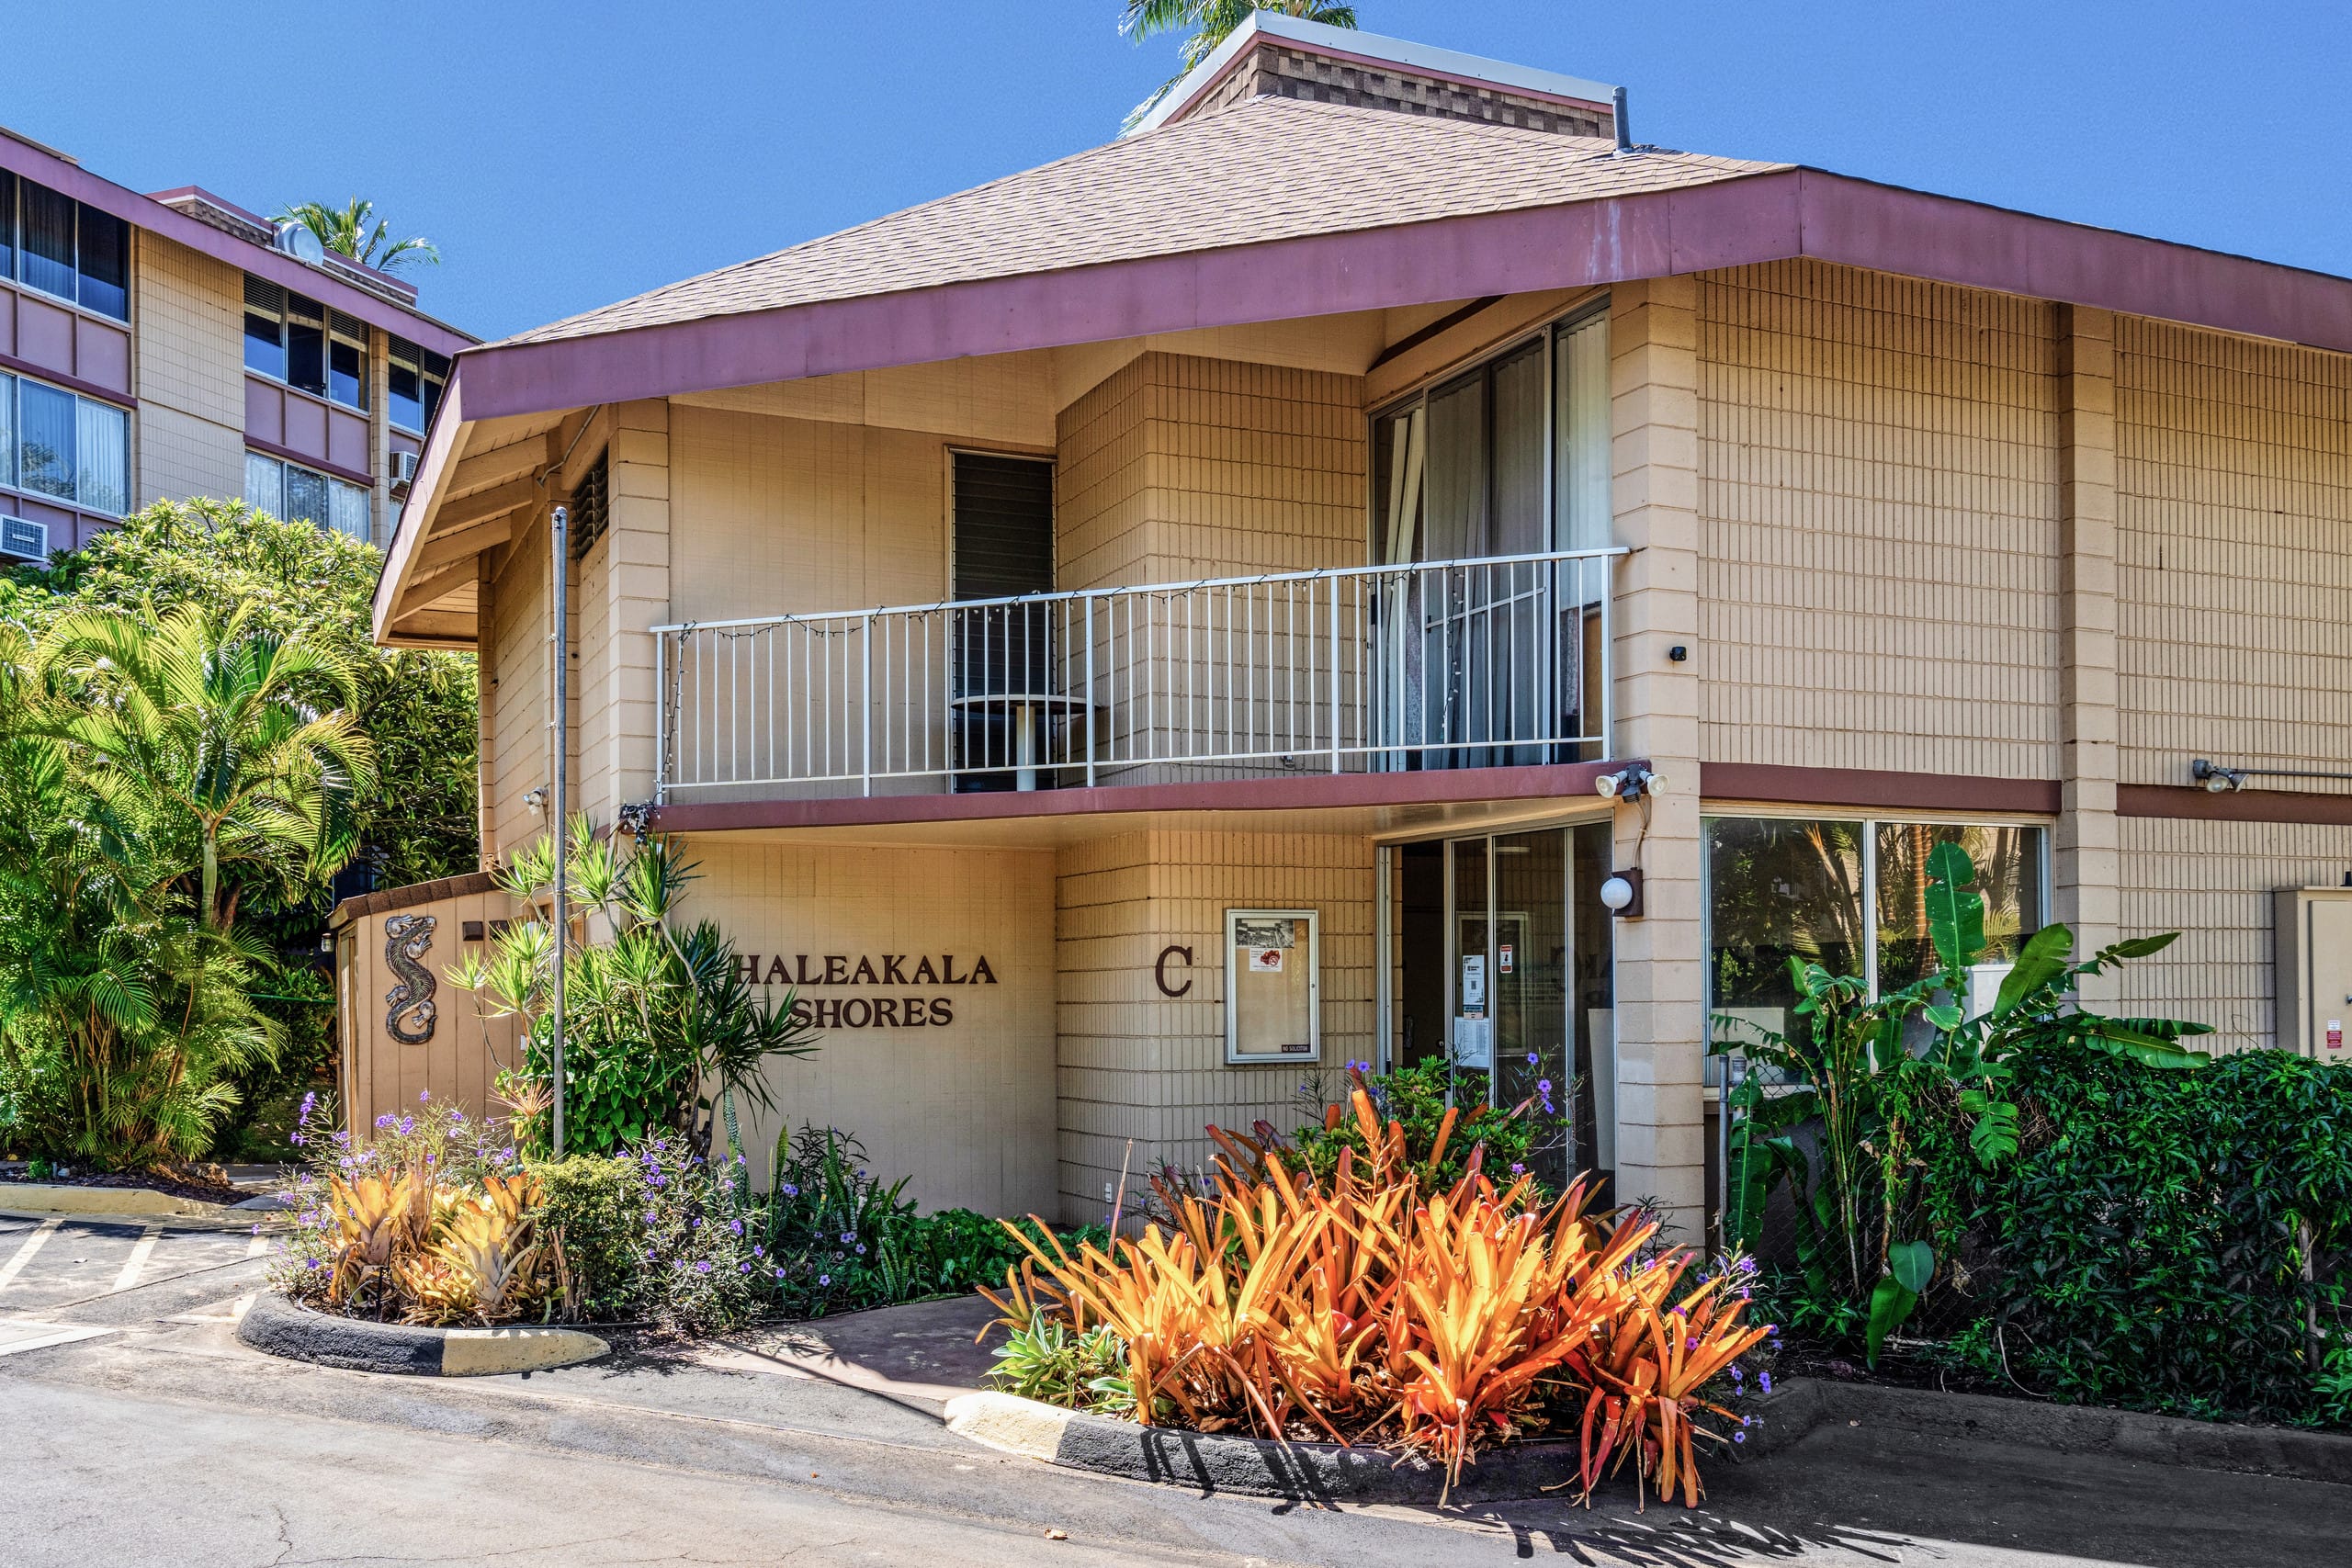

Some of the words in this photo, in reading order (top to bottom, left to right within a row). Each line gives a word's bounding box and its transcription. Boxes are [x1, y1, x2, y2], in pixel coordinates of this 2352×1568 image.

[732, 954, 998, 984] HALEAKALA
[1155, 945, 1193, 998] C
[788, 998, 954, 1028] SHORES
